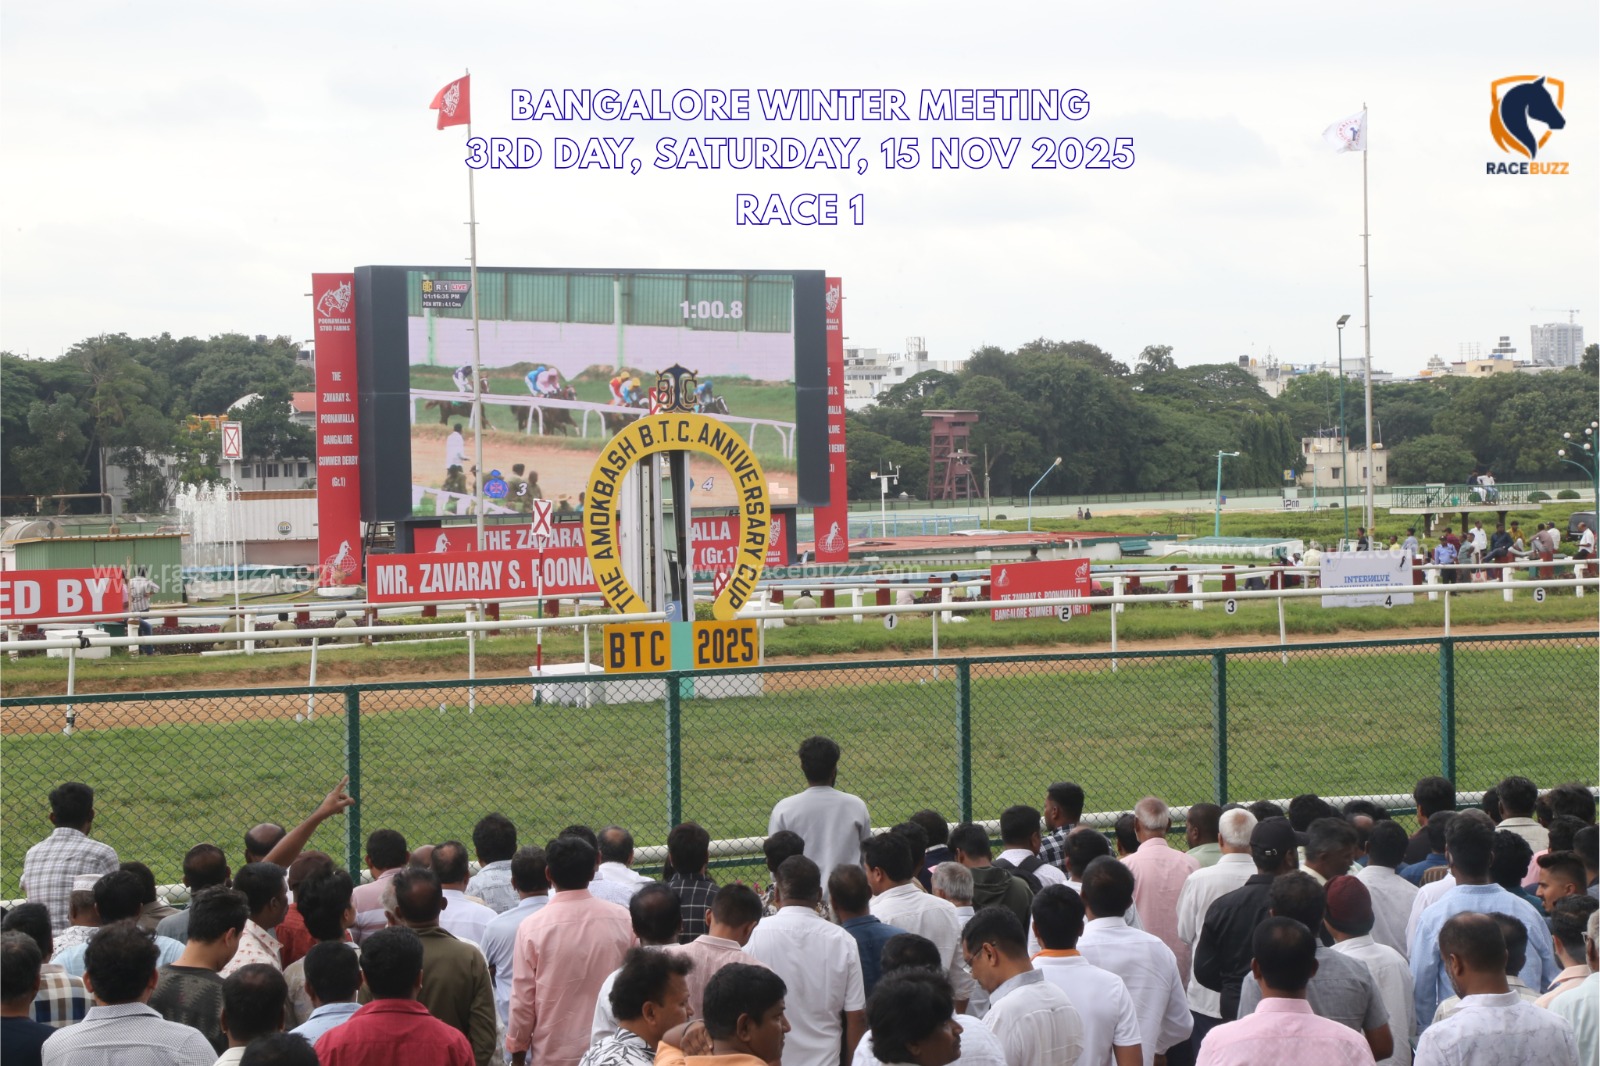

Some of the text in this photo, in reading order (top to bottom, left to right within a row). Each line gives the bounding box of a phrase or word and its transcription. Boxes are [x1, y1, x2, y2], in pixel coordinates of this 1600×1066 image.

[680, 300, 743, 319] 1:00.8
[332, 371, 342, 382] THE
[345, 392, 351, 403] S.
[320, 413, 355, 424] POONAWALLA
[323, 434, 353, 445] BANGALORE
[318, 455, 359, 466] SUMMER DERBY
[516, 482, 528, 496] 3
[701, 476, 714, 491] 4
[590, 420, 765, 614] THE AMOKBASH B.T.C. ANNIVERSARY CUP
[483, 529, 511, 550] THE
[516, 526, 588, 549] ZAVARA
[376, 556, 595, 596] MR. ZAVARAY S. POONA
[1344, 574, 1391, 584] INTERVALVE
[0, 578, 111, 615] ED BY
[1385, 594, 1393, 607] 4
[1536, 589, 1543, 600] 5
[994, 607, 1027, 621] BANGALORE
[1028, 605, 1053, 618] SUMMER
[1227, 599, 1235, 613] 3
[1062, 607, 1069, 620] 2
[609, 628, 753, 669] BTC 2025
